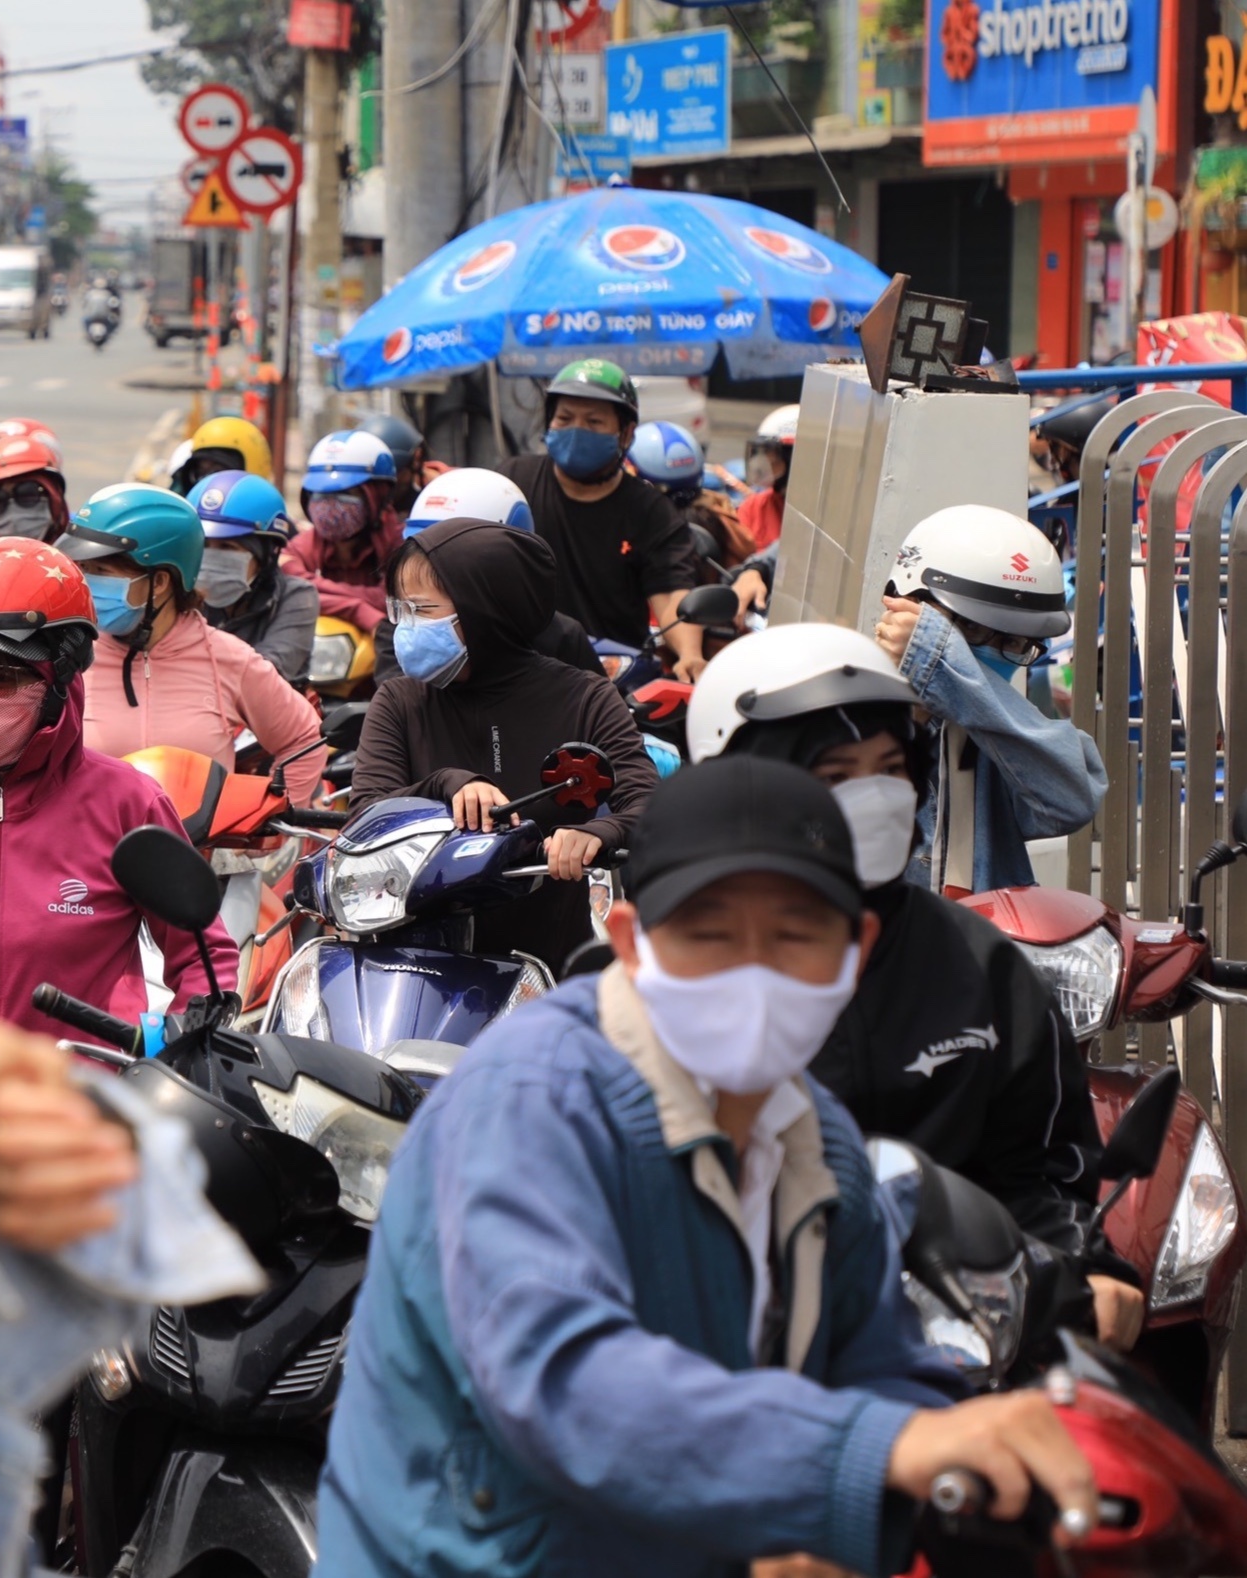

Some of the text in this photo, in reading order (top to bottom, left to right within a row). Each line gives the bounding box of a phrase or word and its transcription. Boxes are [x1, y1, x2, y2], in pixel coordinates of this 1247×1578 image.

[979, 0, 1128, 67] shoptretho
[598, 280, 669, 295] pepsi
[414, 325, 465, 353] pepsi
[1003, 574, 1037, 583] SUZUKI
[491, 726, 501, 773] LIME ORANGE
[48, 902, 94, 915] adidas
[929, 1035, 987, 1056] HADES
